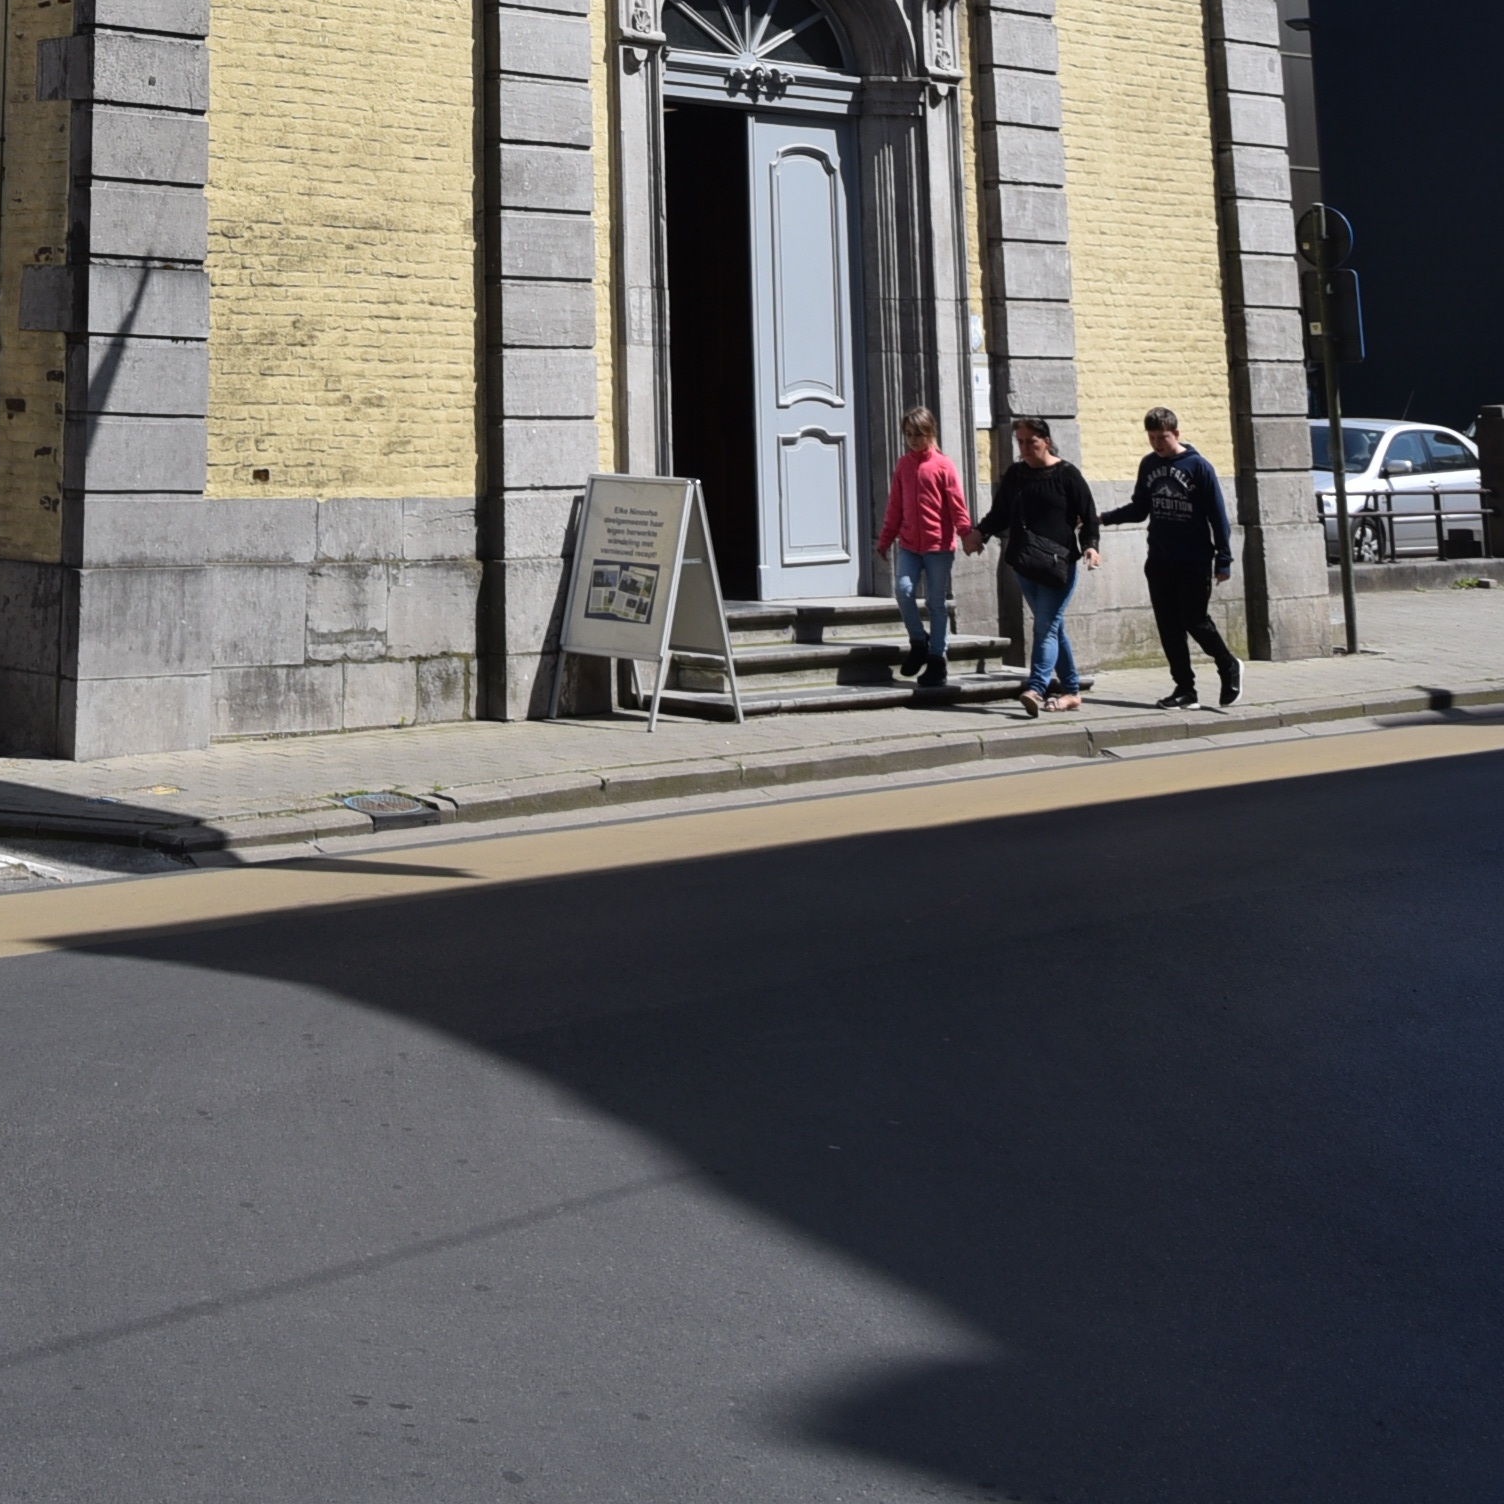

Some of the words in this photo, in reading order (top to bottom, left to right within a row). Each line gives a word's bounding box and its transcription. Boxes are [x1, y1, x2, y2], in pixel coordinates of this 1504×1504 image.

[1169, 466, 1197, 492] FALLS
[614, 506, 628, 514] Elke
[630, 508, 658, 516] Ninoofse
[604, 517, 648, 526] deelgemeente
[650, 519, 664, 527] haar
[607, 528, 624, 536] eigen
[627, 528, 658, 537] herwerkte
[608, 538, 640, 548] wandeling
[600, 548, 634, 556] vernieuwd
